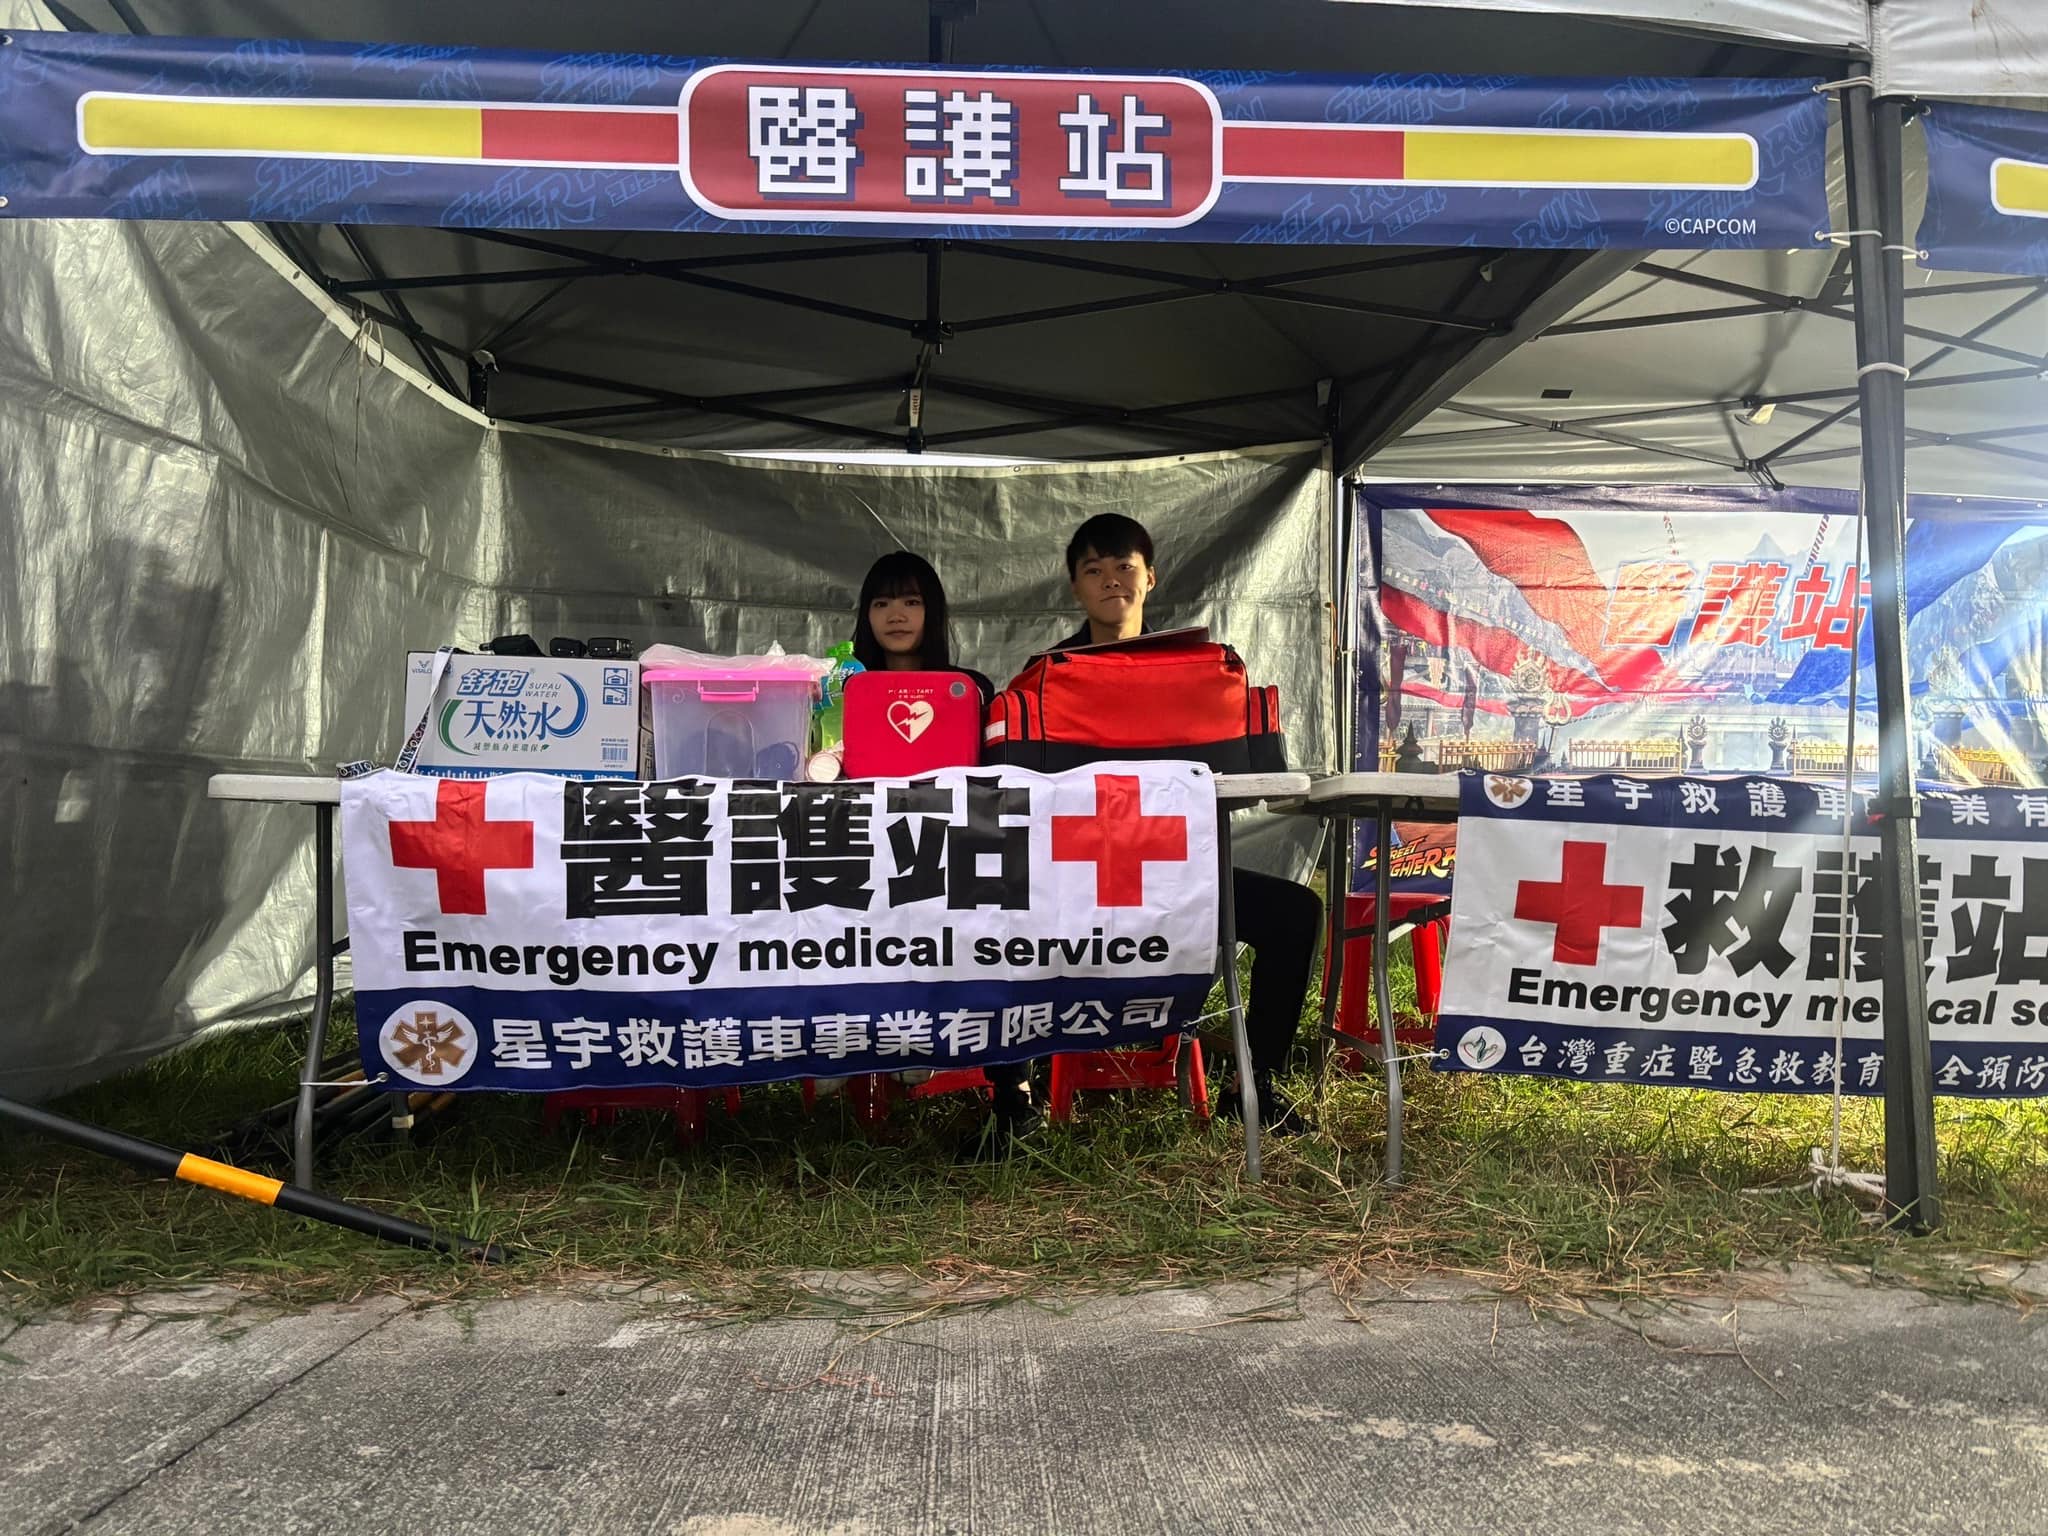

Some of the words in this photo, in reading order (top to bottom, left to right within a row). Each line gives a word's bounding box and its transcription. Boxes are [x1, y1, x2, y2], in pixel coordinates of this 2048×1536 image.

[748, 86, 1166, 201] 醫護站
[1665, 218, 1757, 235] ©CAPCOM
[456, 668, 531, 697] 舒跑
[464, 699, 562, 741] 天然水
[1547, 779, 2048, 828] 星宇救護車業有
[560, 774, 1031, 919] 醫護站
[403, 930, 719, 985] Emergency
[739, 926, 953, 971] medical
[973, 927, 1169, 967] service
[1507, 967, 1793, 1029] Emergency
[1806, 990, 1998, 1026] mecal
[490, 996, 1175, 1070] 星宇救護車事業有限公司
[1518, 1035, 2048, 1090] 台灣重症暨急救教育全預防
